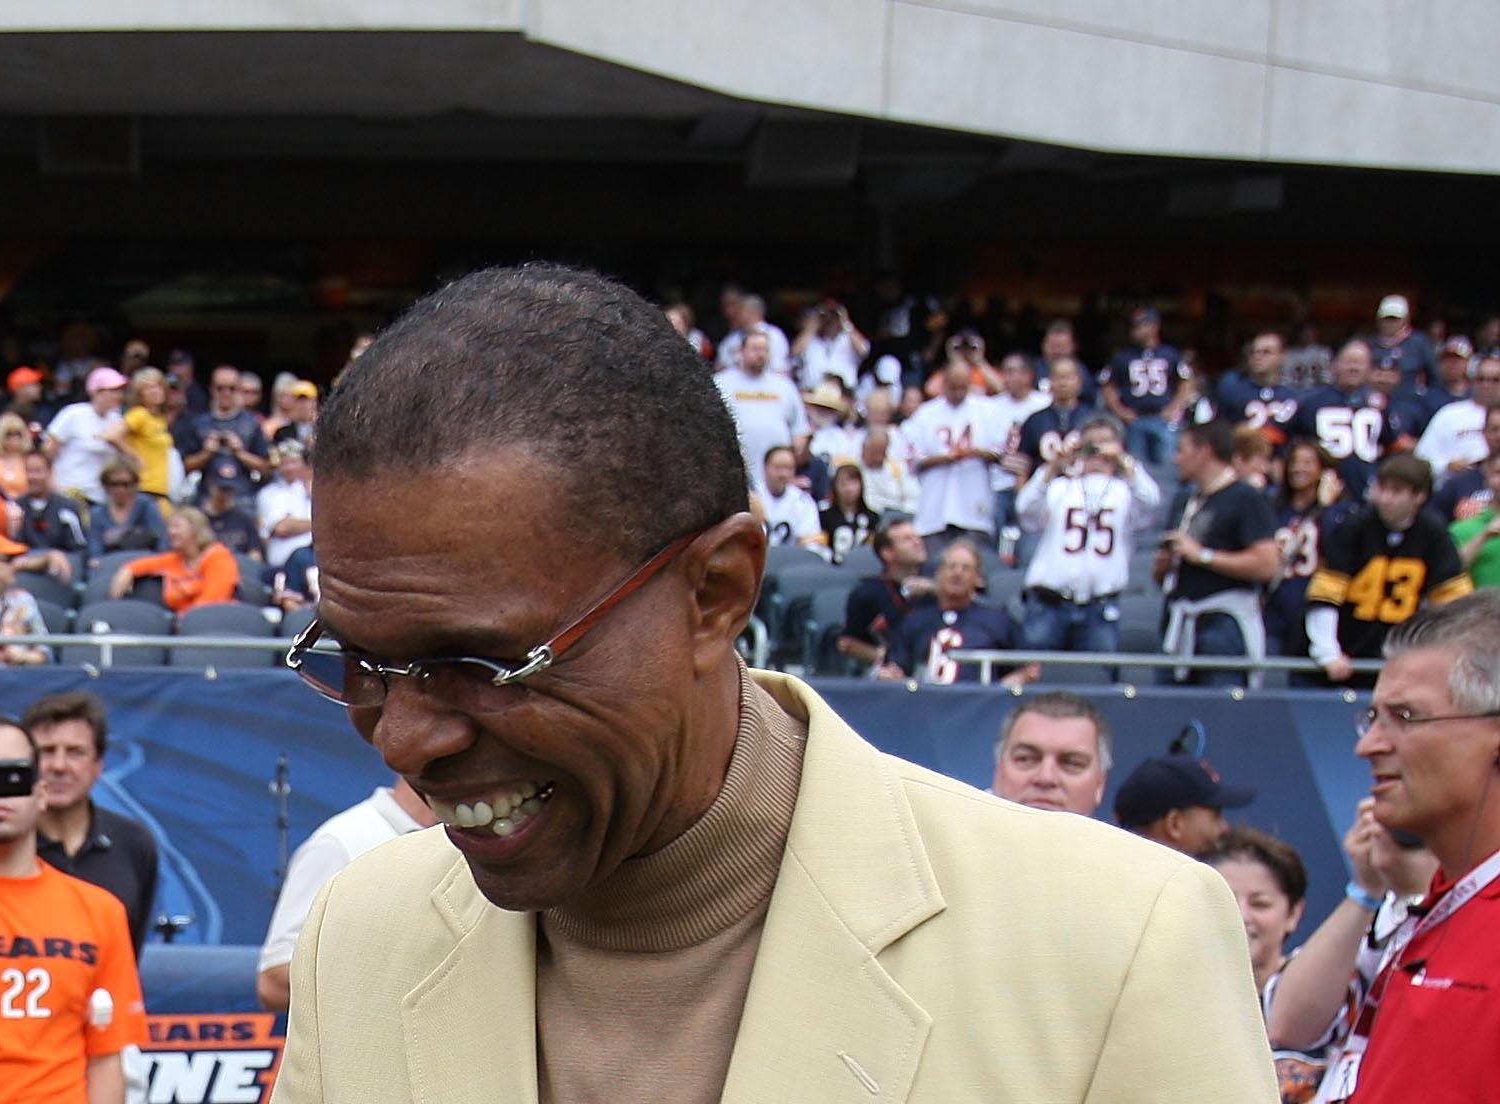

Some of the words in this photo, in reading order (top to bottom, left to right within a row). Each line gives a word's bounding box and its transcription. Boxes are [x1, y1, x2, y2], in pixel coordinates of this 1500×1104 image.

[1316, 407, 1383, 463] 50
[1064, 507, 1114, 556] 55
[1346, 554, 1428, 624] 43
[0, 966, 52, 1019] 22
